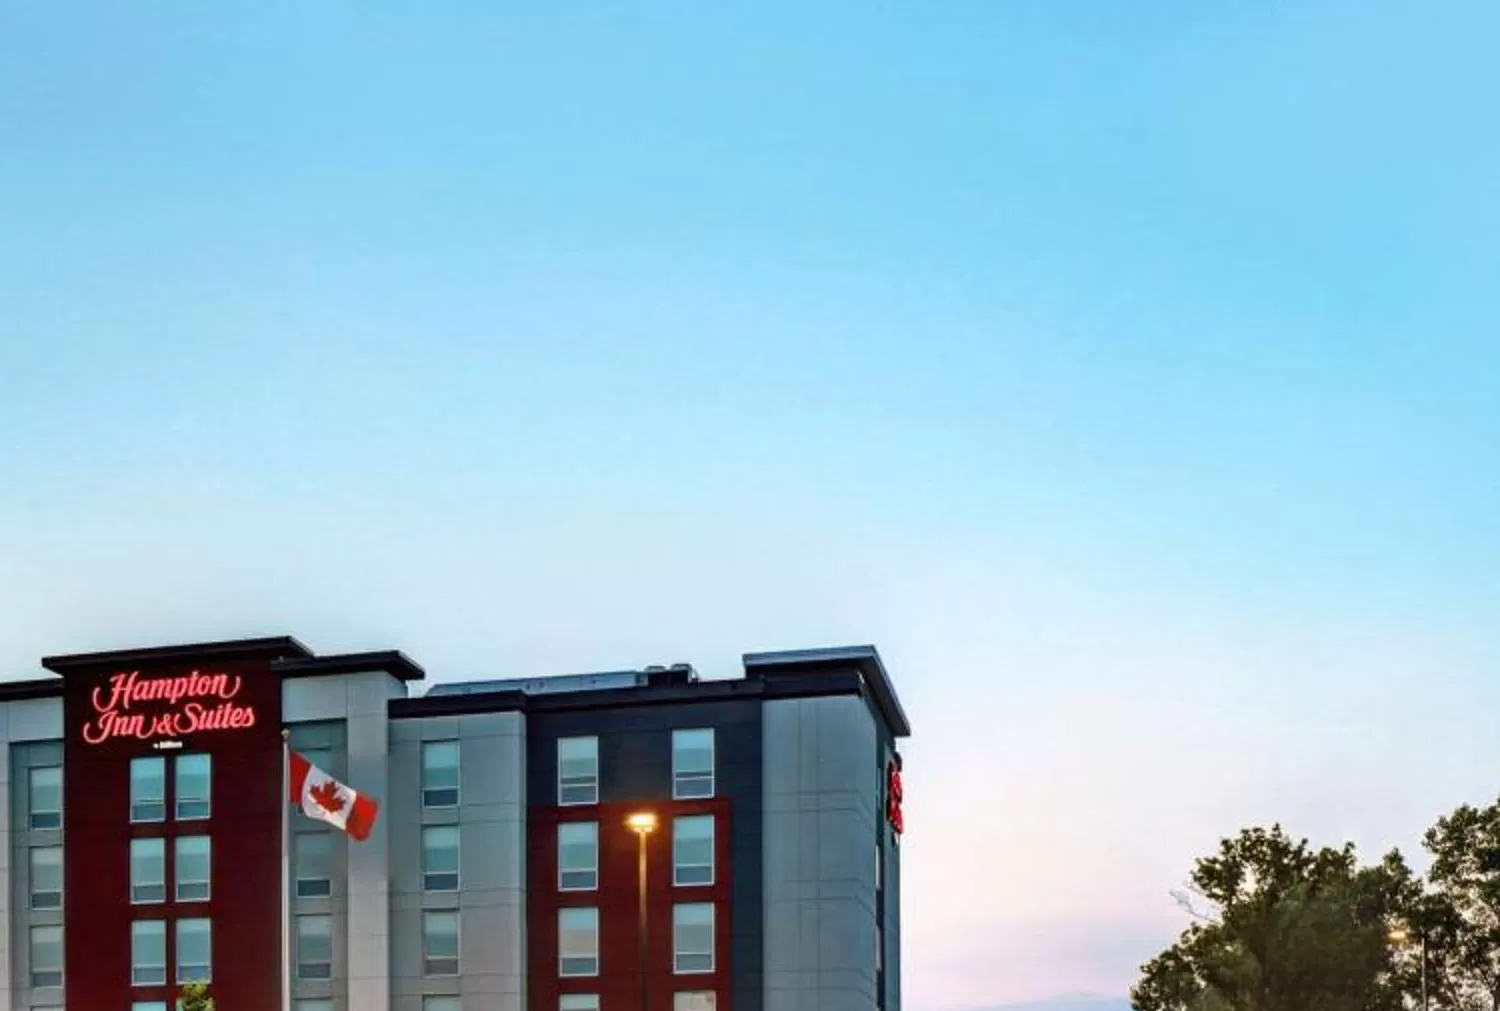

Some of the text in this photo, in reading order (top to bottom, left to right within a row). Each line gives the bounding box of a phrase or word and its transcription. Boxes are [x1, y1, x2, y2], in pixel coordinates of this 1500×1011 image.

[92, 670, 241, 712] Hampton
[83, 701, 255, 744] Inn & Suites
